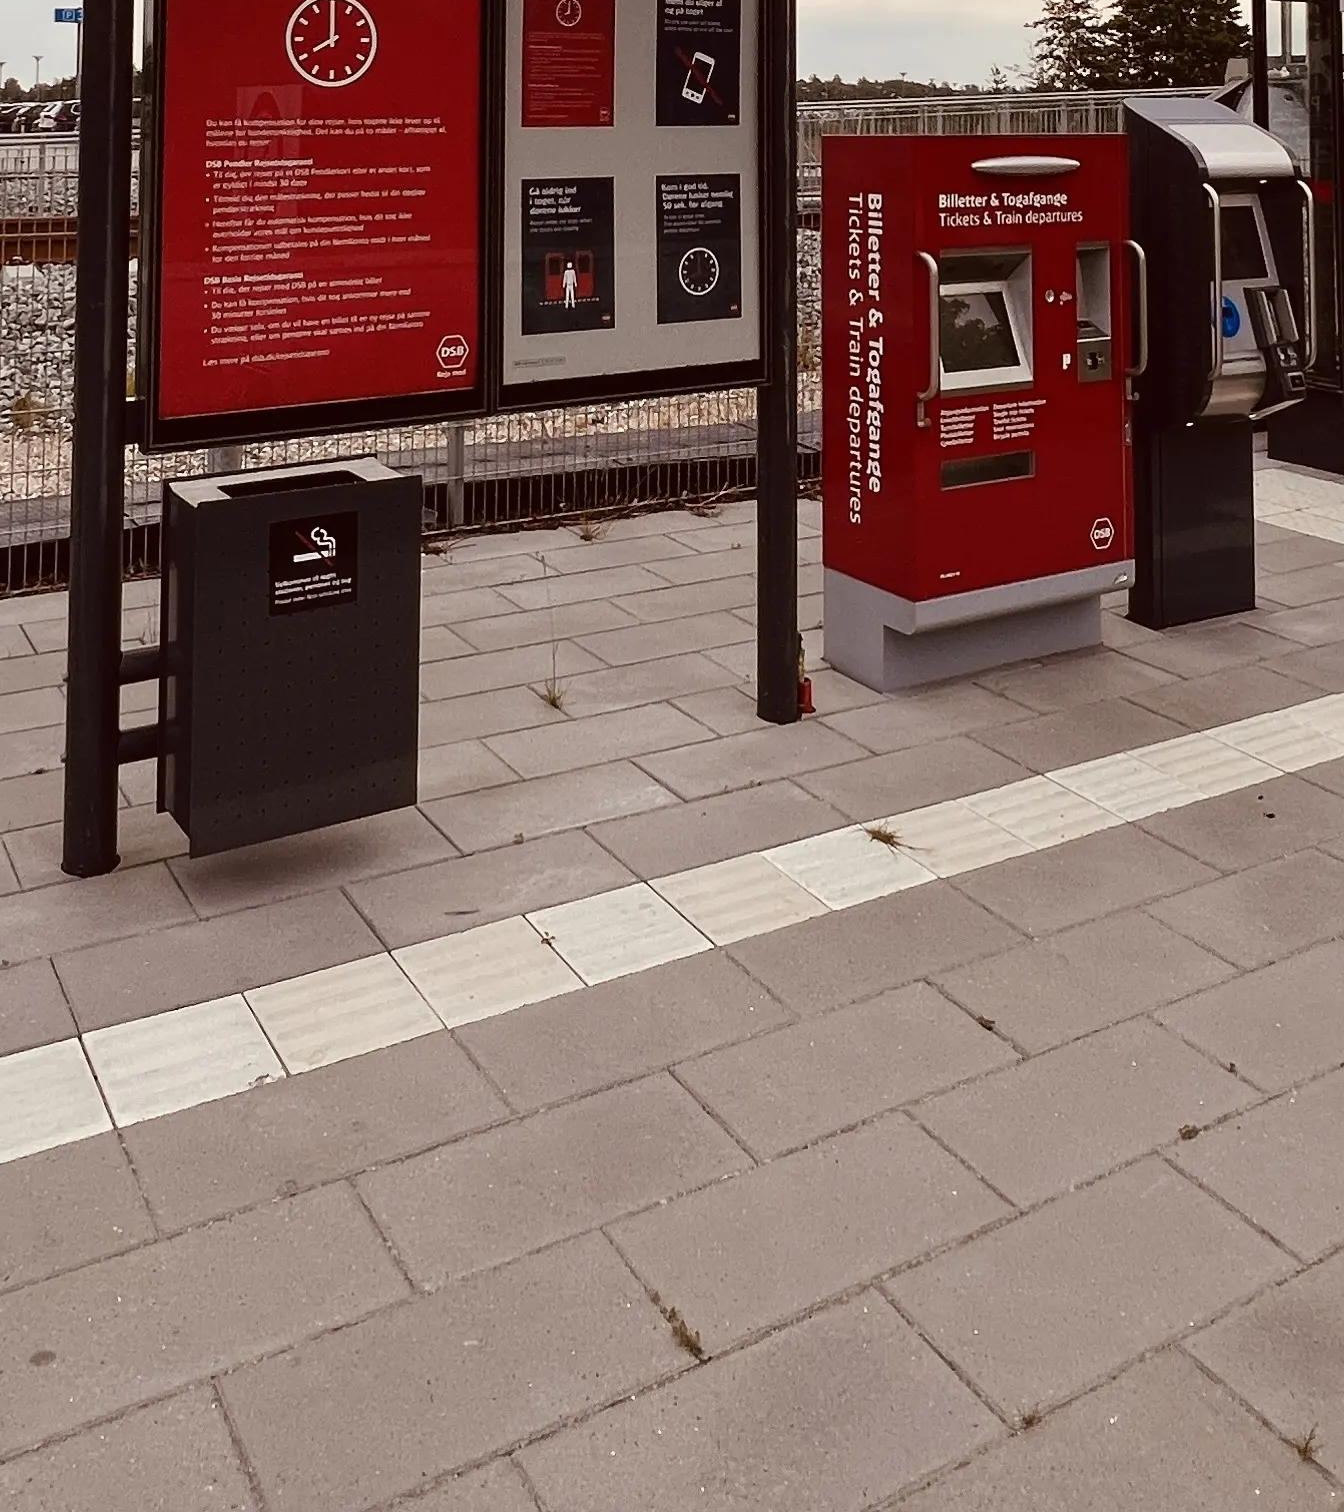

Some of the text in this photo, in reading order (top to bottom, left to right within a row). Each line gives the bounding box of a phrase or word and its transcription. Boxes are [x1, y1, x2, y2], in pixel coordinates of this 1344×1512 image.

[938, 192, 1068, 208] Billetter & Togafgange
[938, 210, 1084, 227] Tickets & Train departures
[441, 345, 465, 357] DSB
[865, 193, 883, 493] Billetter & Togafgange
[846, 193, 864, 524] Tickets & Train departures
[1094, 528, 1111, 540] DSB
